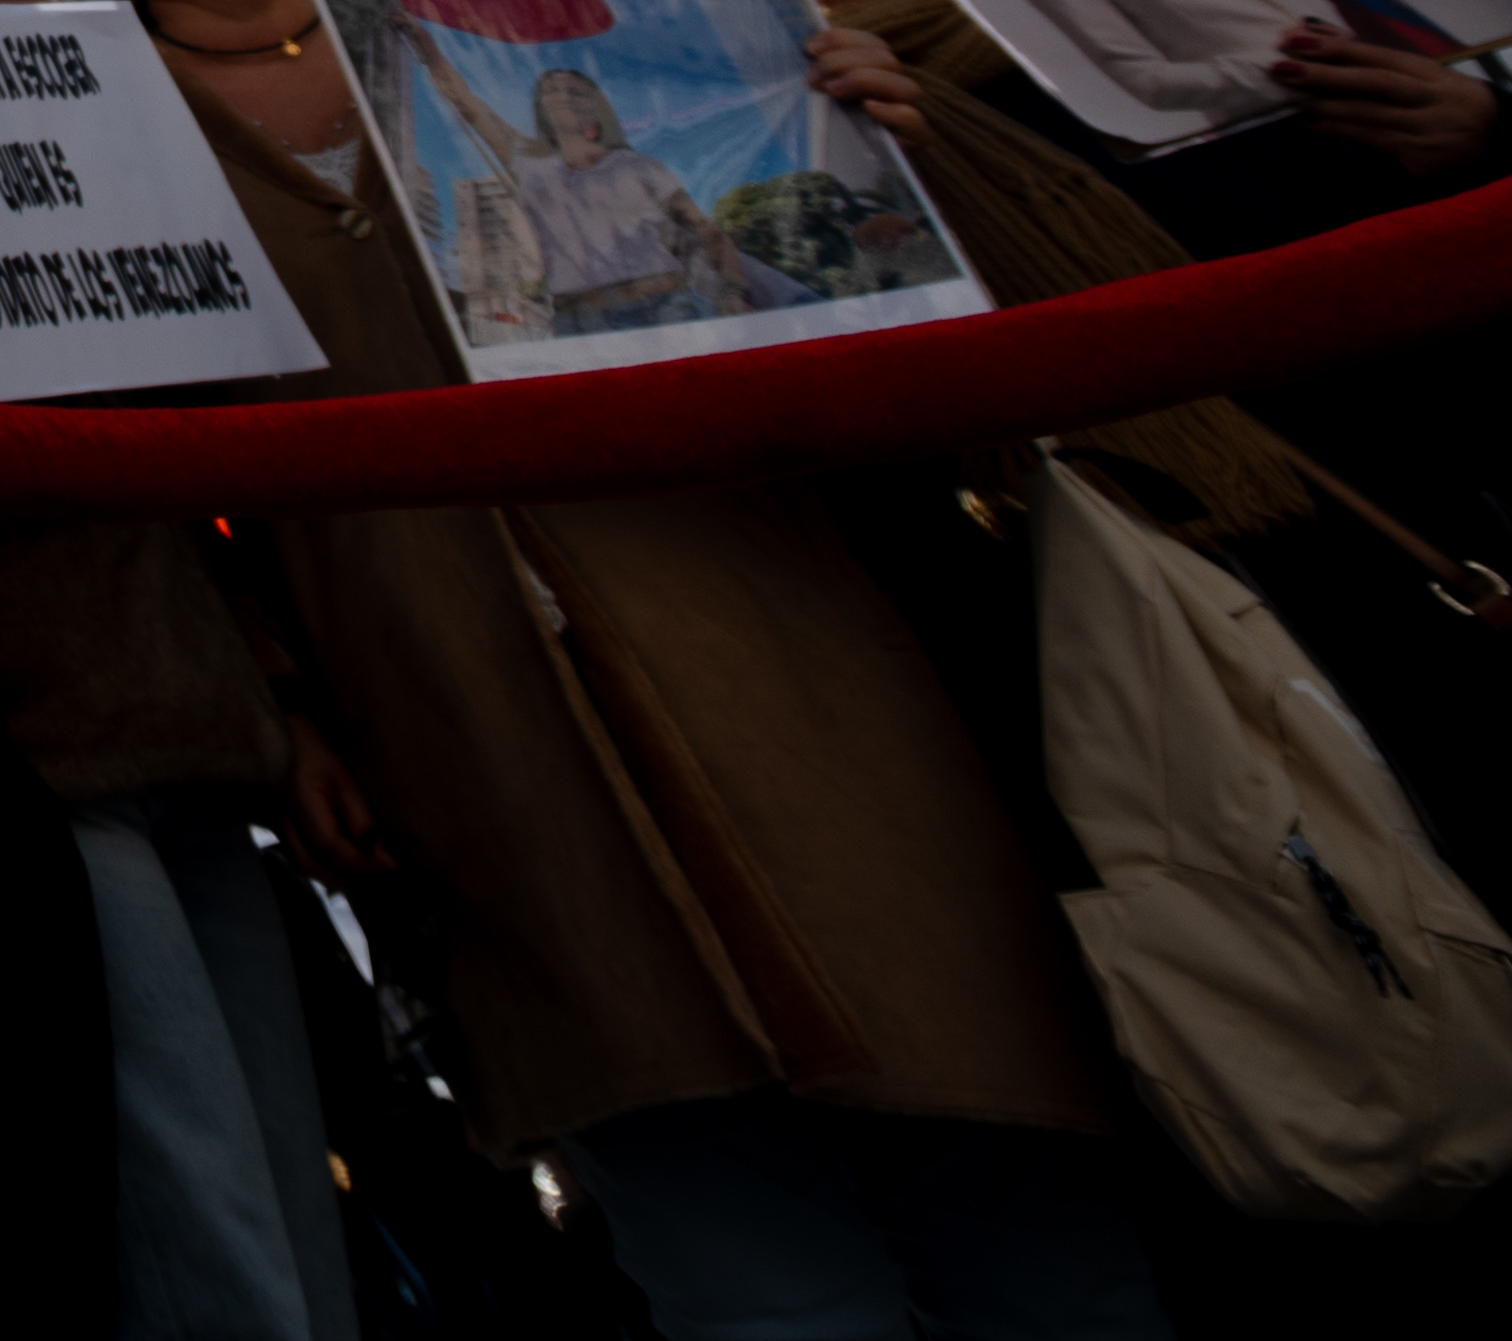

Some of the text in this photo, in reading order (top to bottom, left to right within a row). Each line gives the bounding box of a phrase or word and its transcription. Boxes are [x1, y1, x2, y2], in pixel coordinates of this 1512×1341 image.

[3, 32, 102, 101] ESCOGER
[39, 139, 85, 208] ES
[40, 251, 88, 323] DE
[67, 246, 125, 323] LOS
[106, 238, 252, 320] VENEZOLANOS
